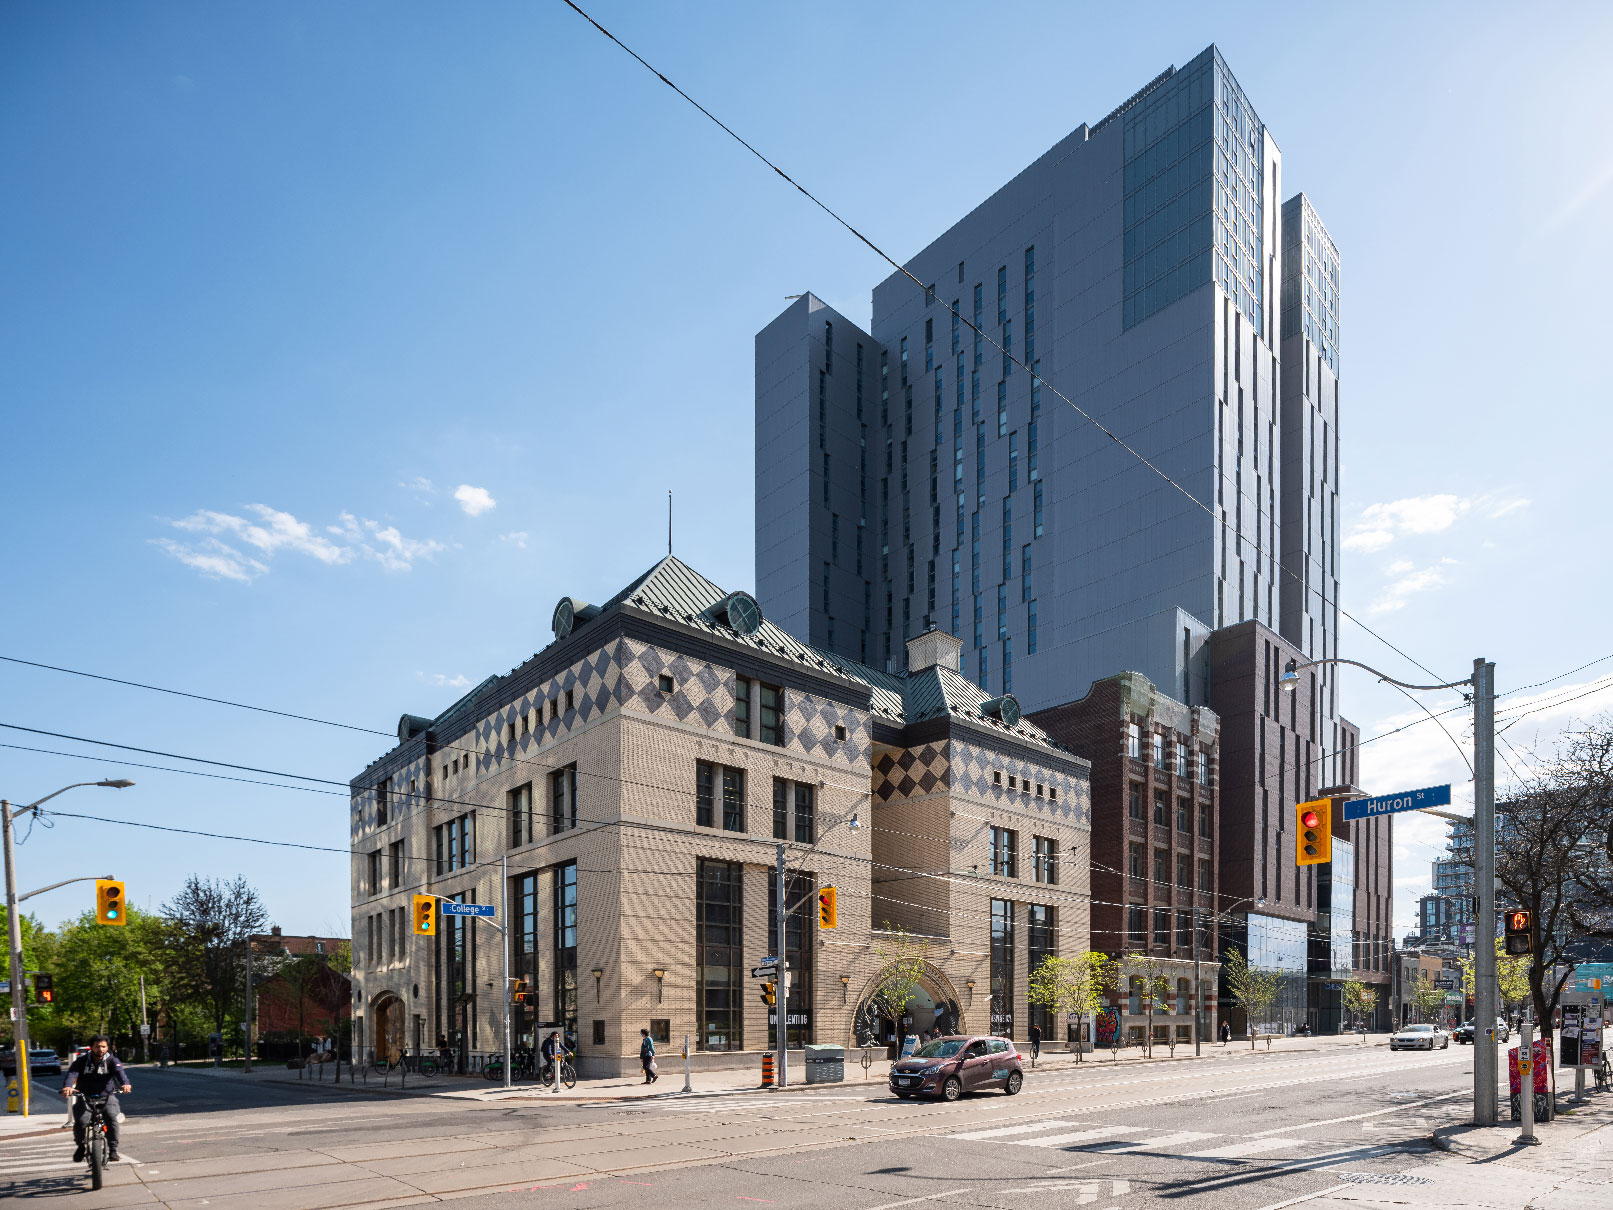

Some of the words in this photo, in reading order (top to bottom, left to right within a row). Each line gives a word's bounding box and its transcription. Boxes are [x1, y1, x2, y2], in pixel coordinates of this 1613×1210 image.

[1367, 796, 1413, 814] Huron
[1416, 792, 1425, 800] St
[451, 904, 480, 915] College
[42, 991, 52, 1001] 4
